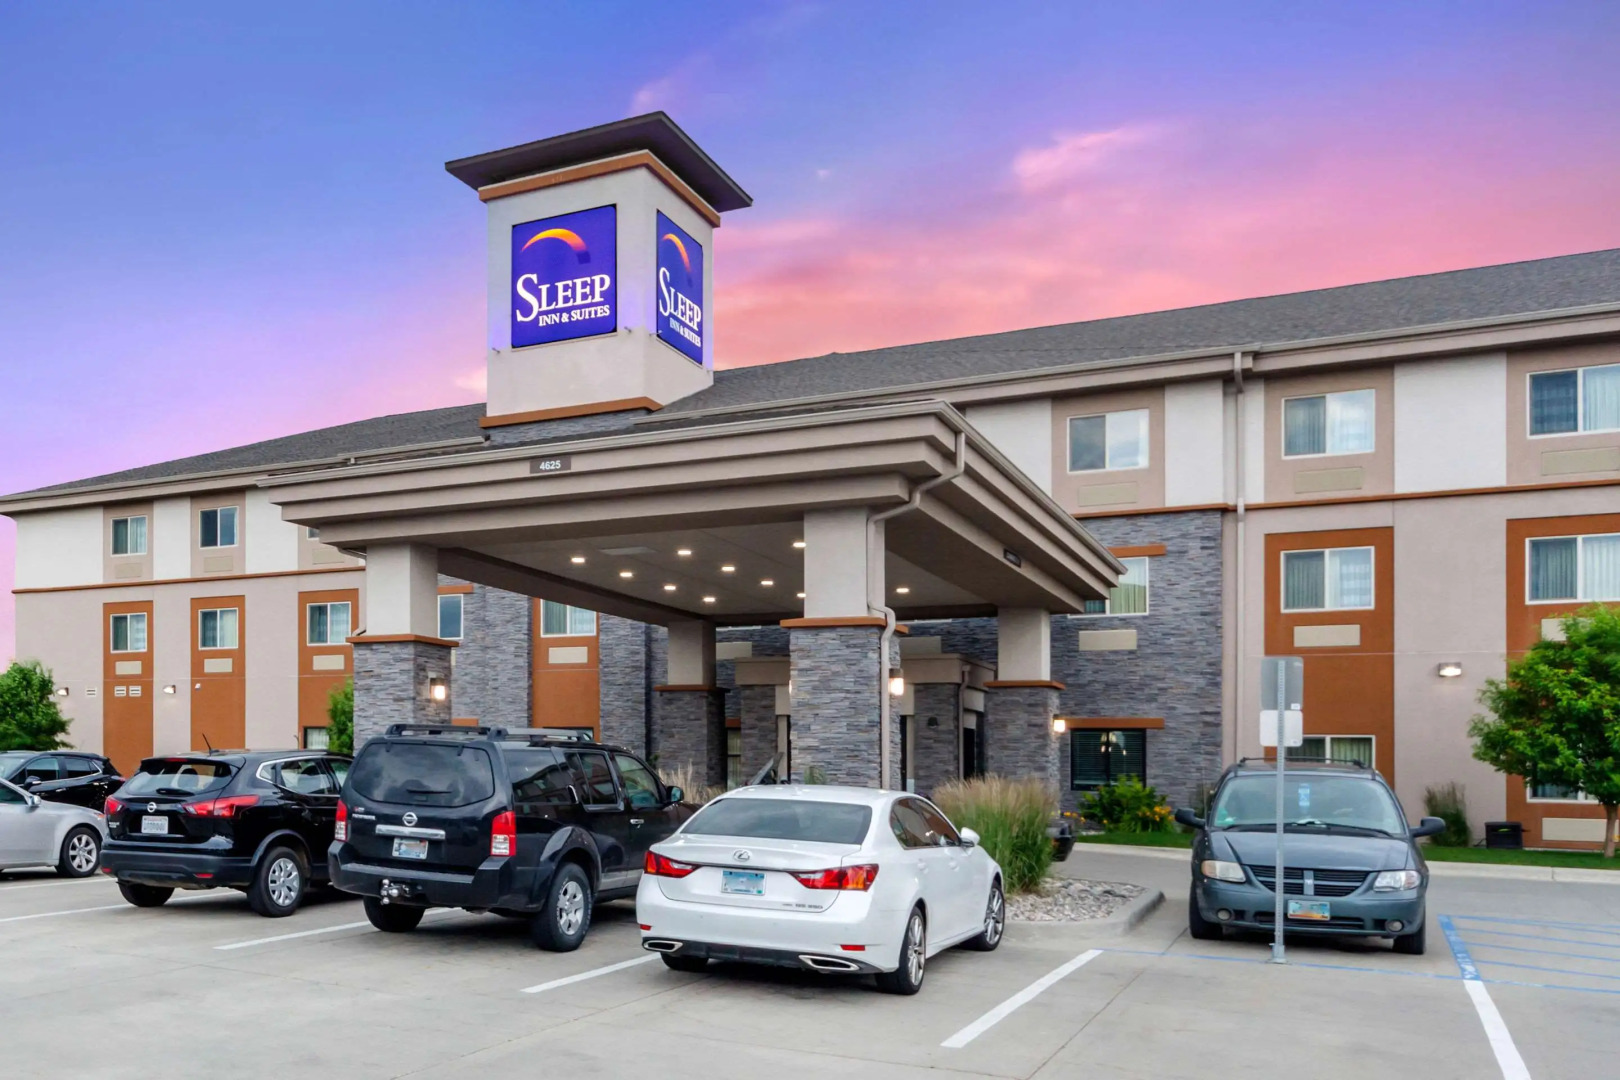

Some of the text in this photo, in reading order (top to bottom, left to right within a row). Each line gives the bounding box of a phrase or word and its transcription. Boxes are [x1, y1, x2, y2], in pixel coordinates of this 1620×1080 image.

[516, 273, 611, 322] SLEEP
[538, 304, 610, 327] INN & SUITES
[659, 267, 702, 331] SLEEP
[539, 460, 561, 470] 4625
